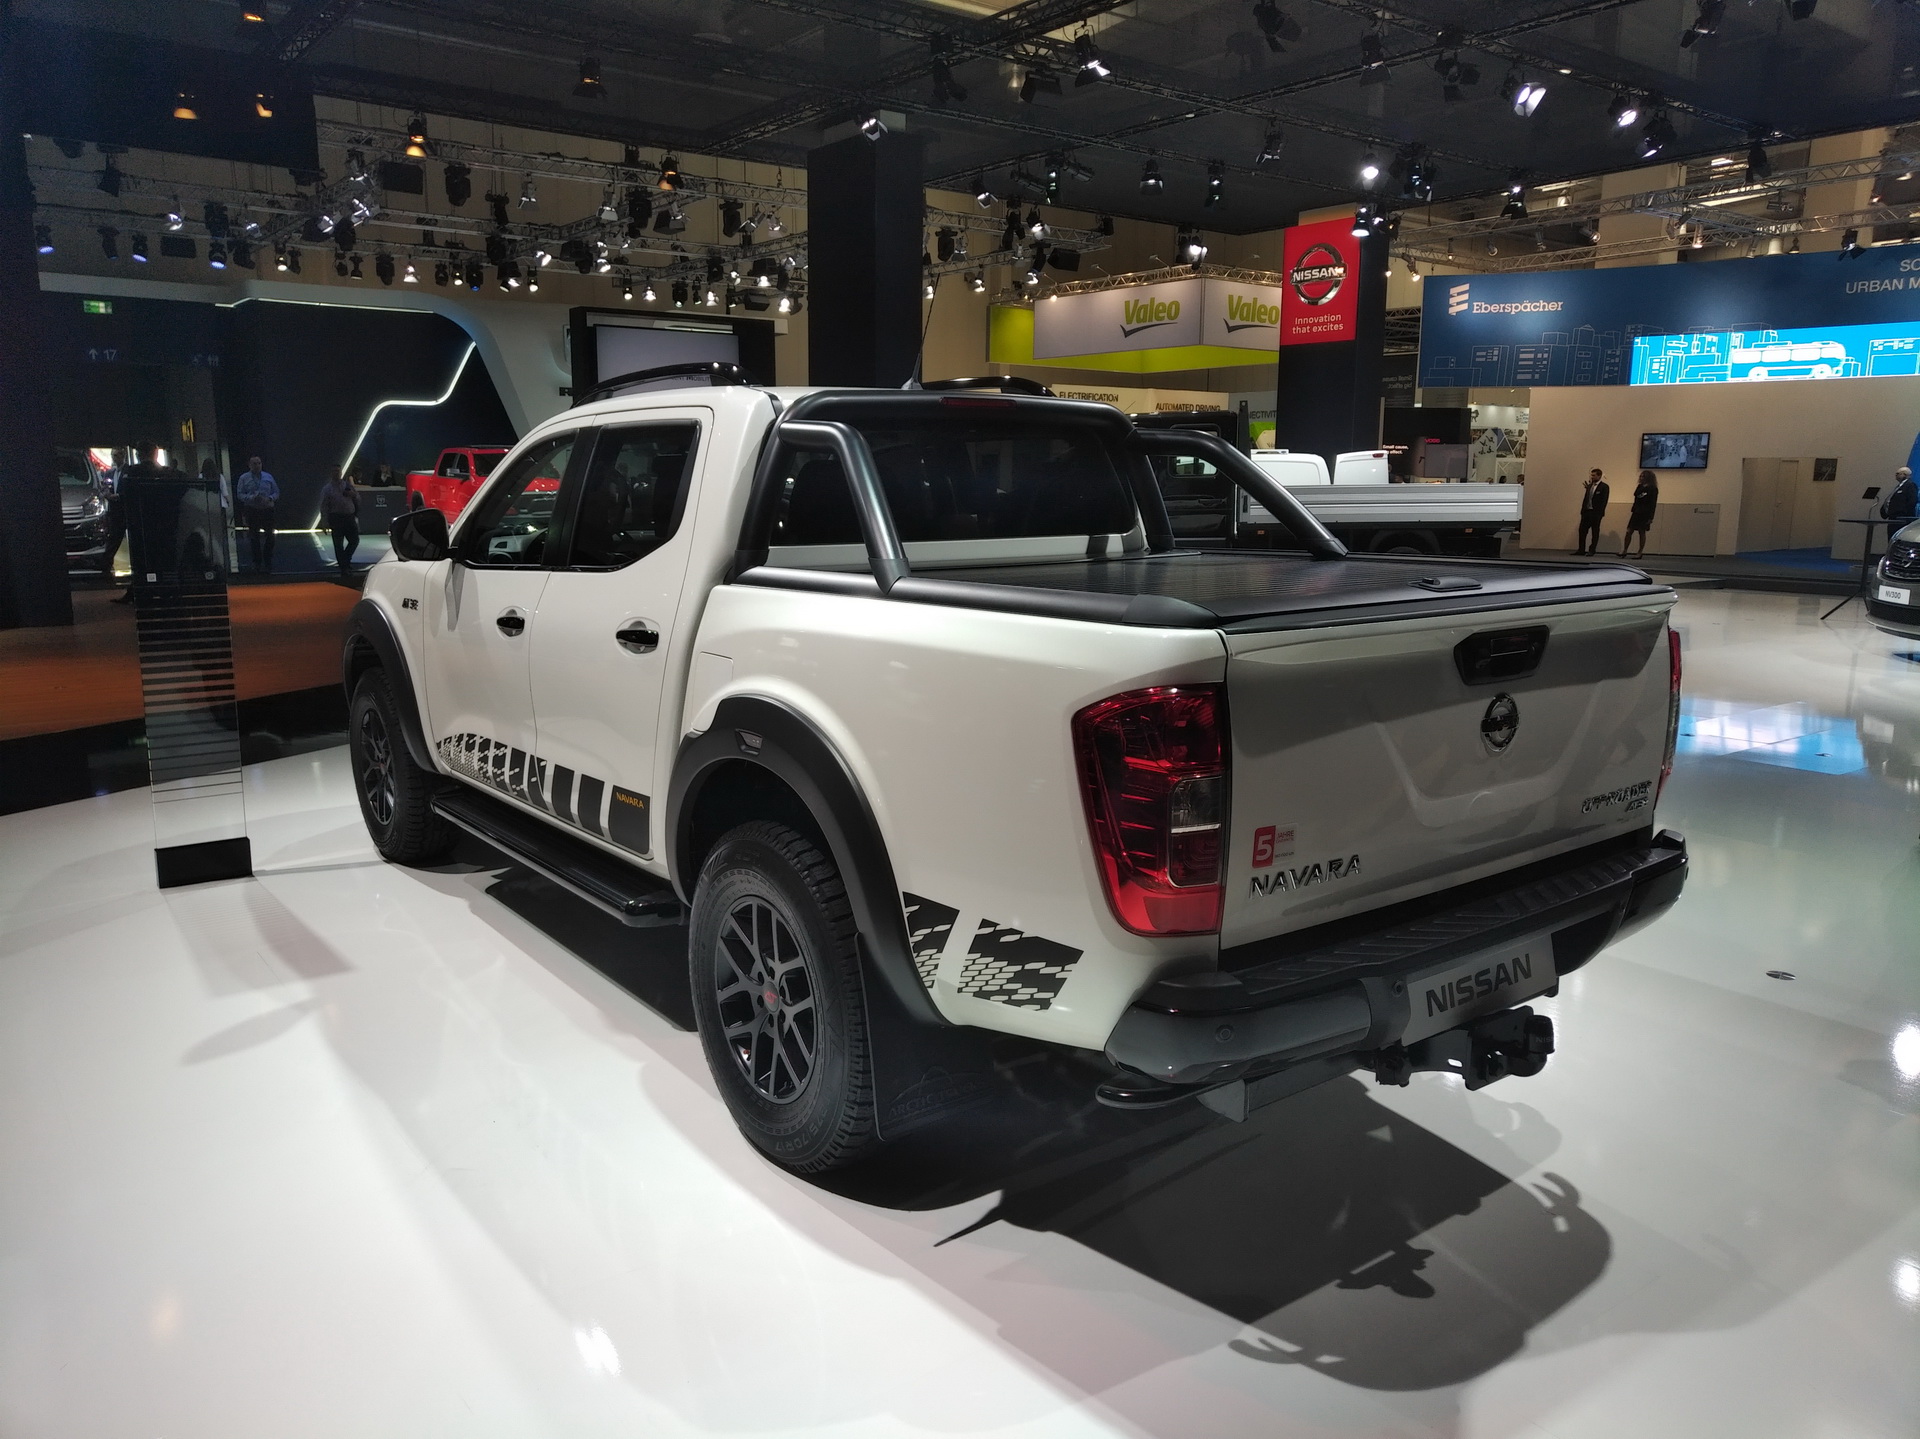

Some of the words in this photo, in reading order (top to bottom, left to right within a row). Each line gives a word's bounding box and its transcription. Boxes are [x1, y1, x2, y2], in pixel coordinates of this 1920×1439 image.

[1292, 266, 1338, 282] NISSAN
[1845, 278, 1904, 294] URBAN
[1124, 296, 1181, 325] Valeo
[1227, 294, 1280, 325] Valeo
[1472, 300, 1564, 315] Eberspächer
[1294, 313, 1342, 325] Innovation
[1292, 325, 1310, 334] that
[1312, 322, 1344, 333] excites
[103, 349, 117, 360] 17
[1059, 391, 1119, 402] ELECTRIFICATION
[1155, 402, 1194, 412] AUTOMATED
[1195, 404, 1221, 412] DRIVING
[1249, 410, 1277, 419] ECTIVIT
[615, 791, 645, 810] NAVARA
[1277, 830, 1295, 839] JAHRE
[1255, 833, 1273, 862] 5
[1249, 854, 1361, 899] NAVARA
[1425, 953, 1532, 1018] NISSAN
